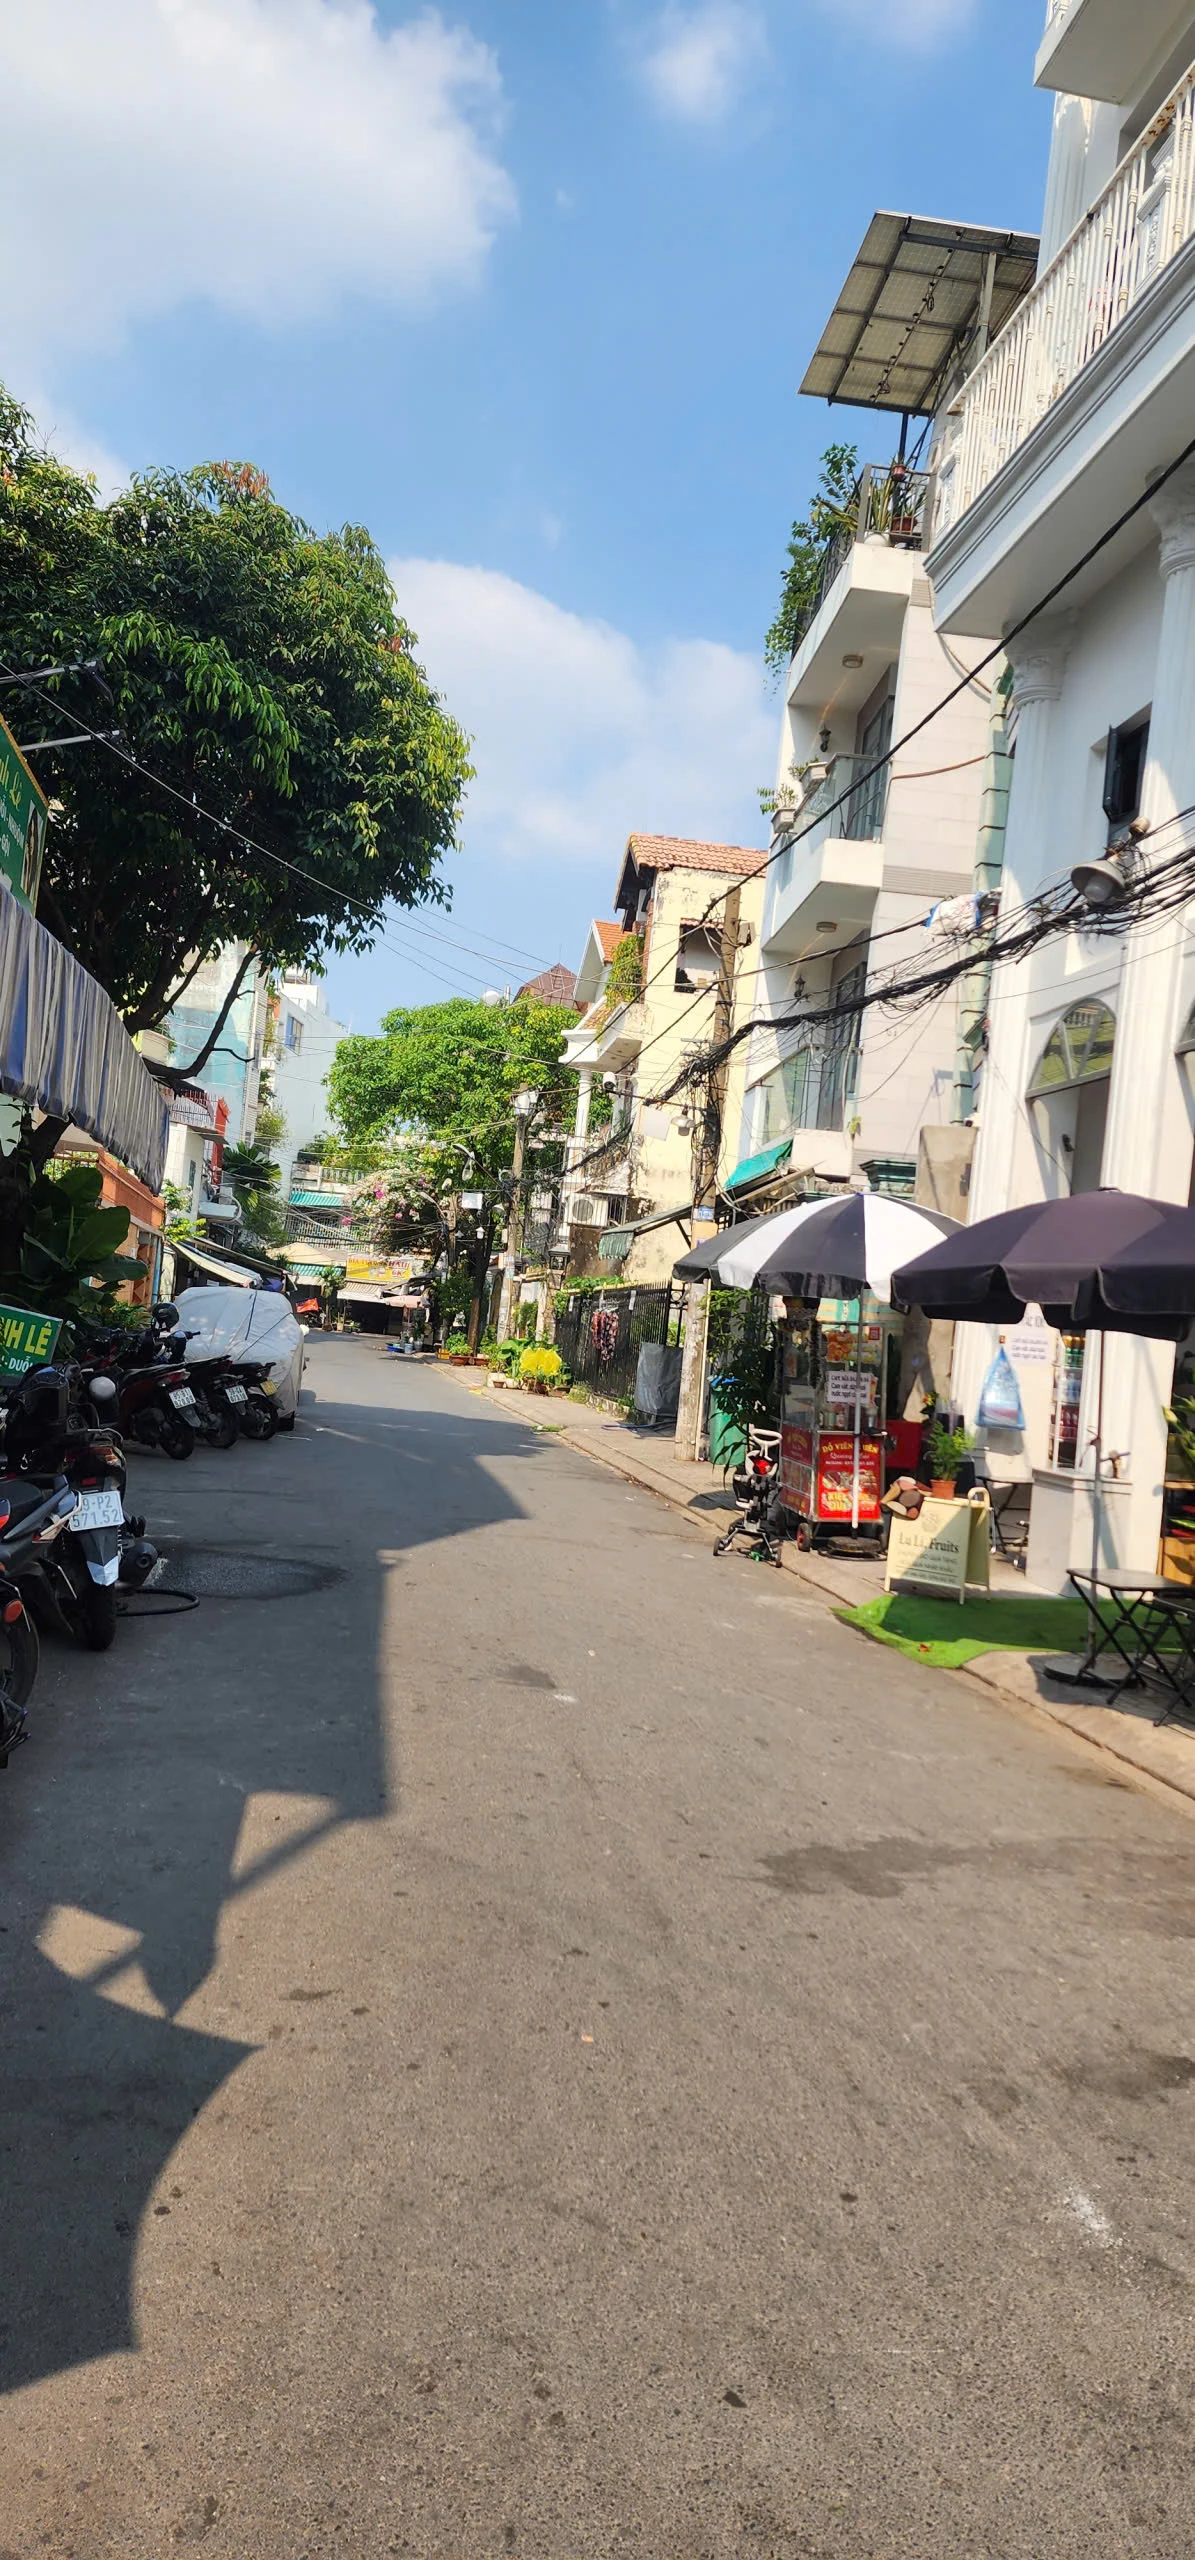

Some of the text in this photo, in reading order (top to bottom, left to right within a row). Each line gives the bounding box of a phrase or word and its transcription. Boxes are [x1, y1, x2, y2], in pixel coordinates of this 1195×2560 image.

[24, 1321, 53, 1356] LÊ
[72, 1508, 119, 1529] 571.52
[928, 1538, 960, 1553] Fruits
